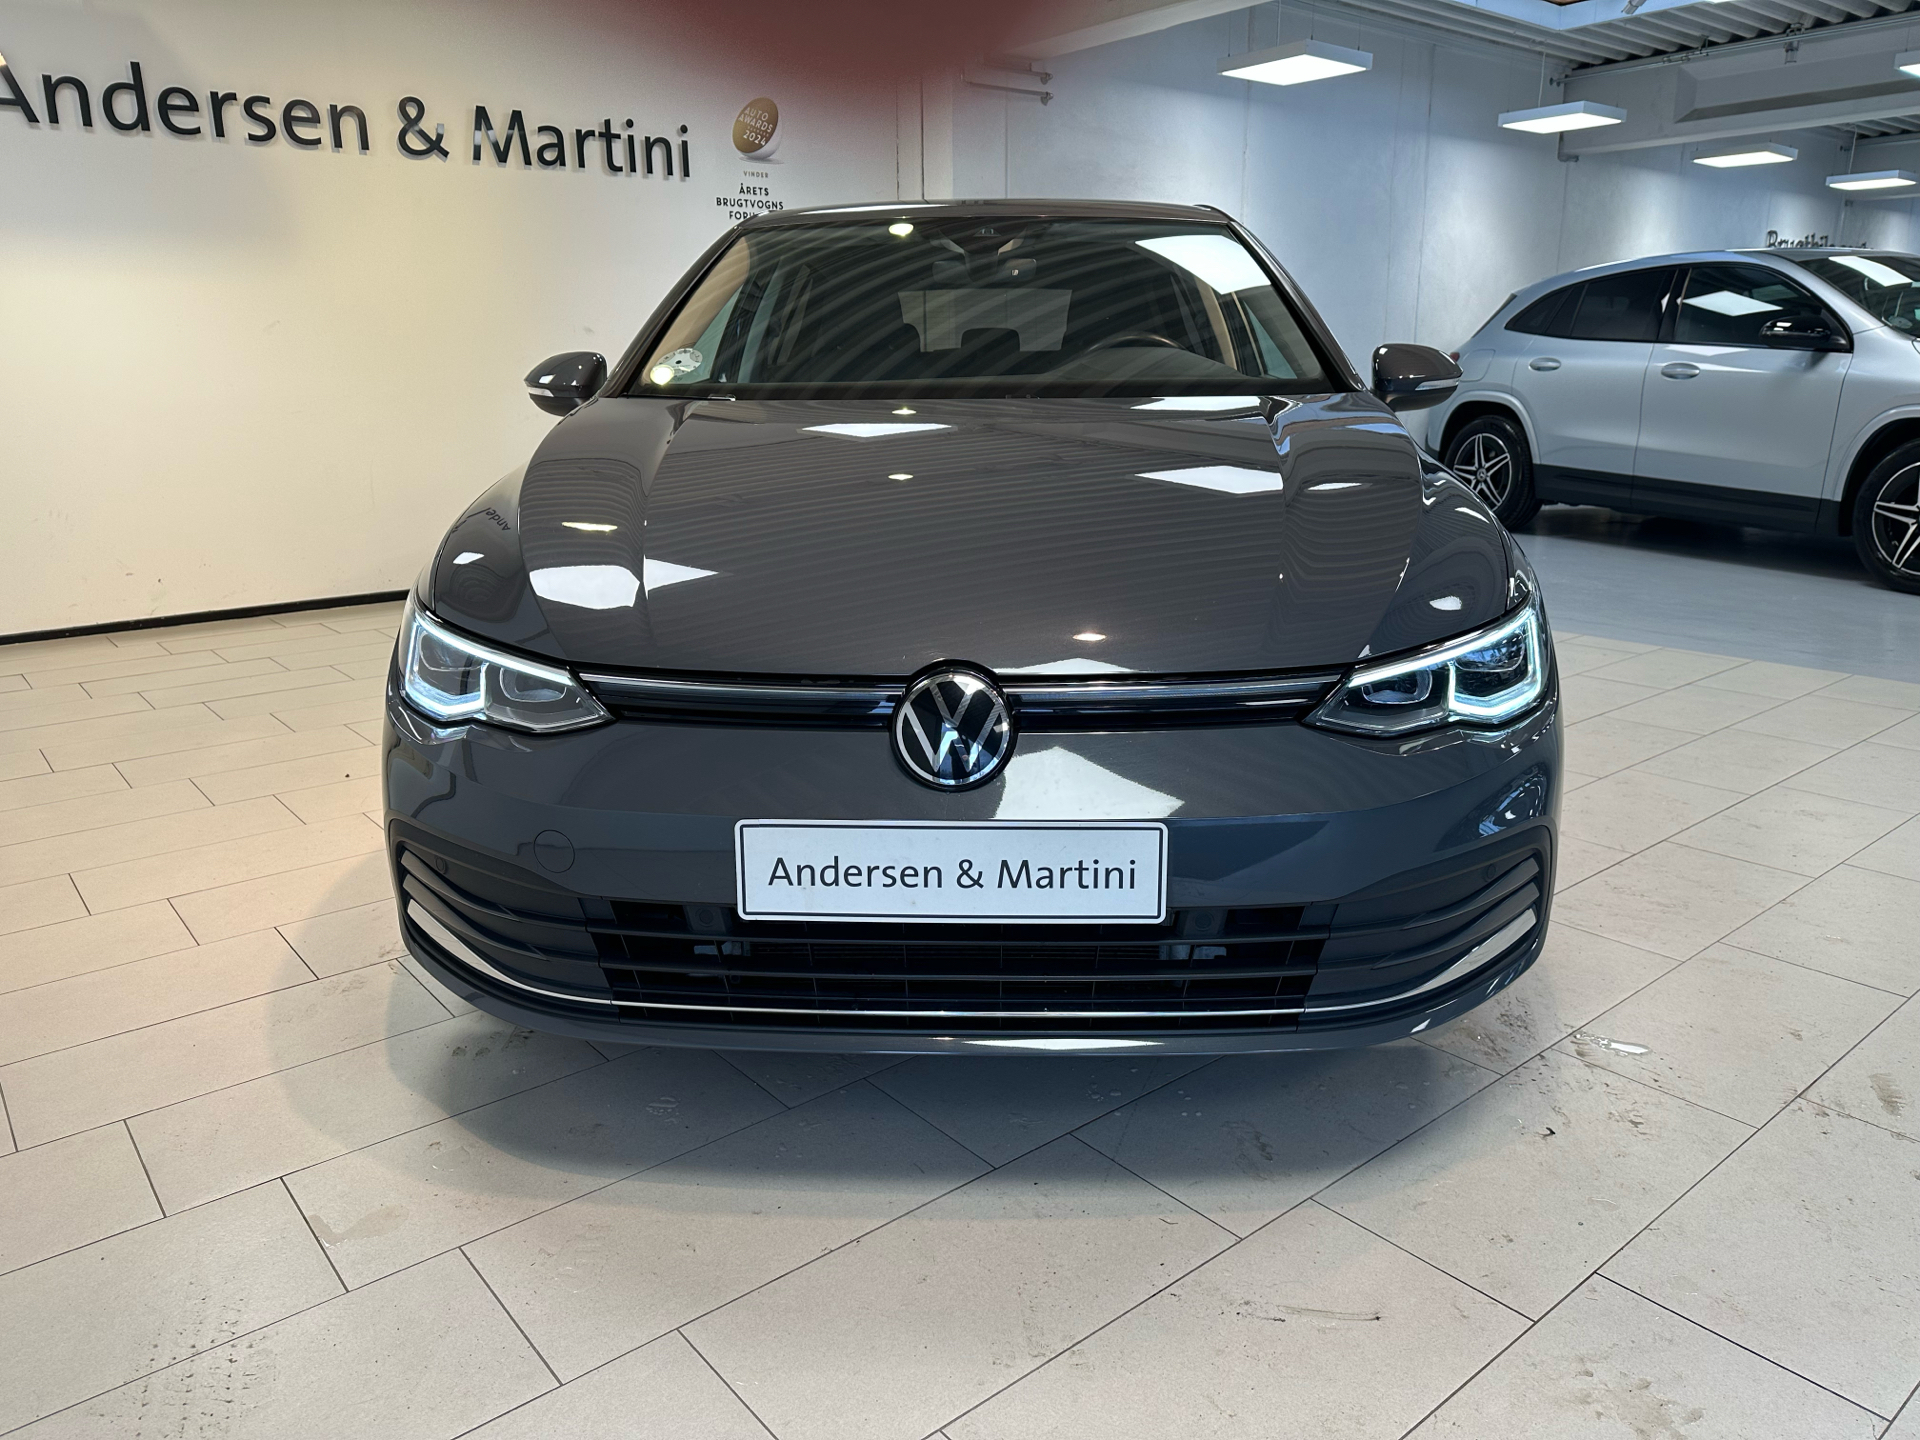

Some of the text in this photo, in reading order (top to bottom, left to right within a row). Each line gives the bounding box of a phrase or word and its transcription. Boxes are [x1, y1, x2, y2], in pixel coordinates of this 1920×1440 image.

[744, 106, 769, 121] AUTO
[738, 113, 774, 133] AWARDS
[397, 96, 450, 159] &
[473, 105, 690, 178] Martini
[743, 129, 767, 146] 2024
[743, 170, 769, 179] VINDER
[739, 183, 770, 196] ÅRETS
[716, 197, 784, 211] BRUGTVOGNS
[768, 855, 1137, 890] Andersen & Martini
